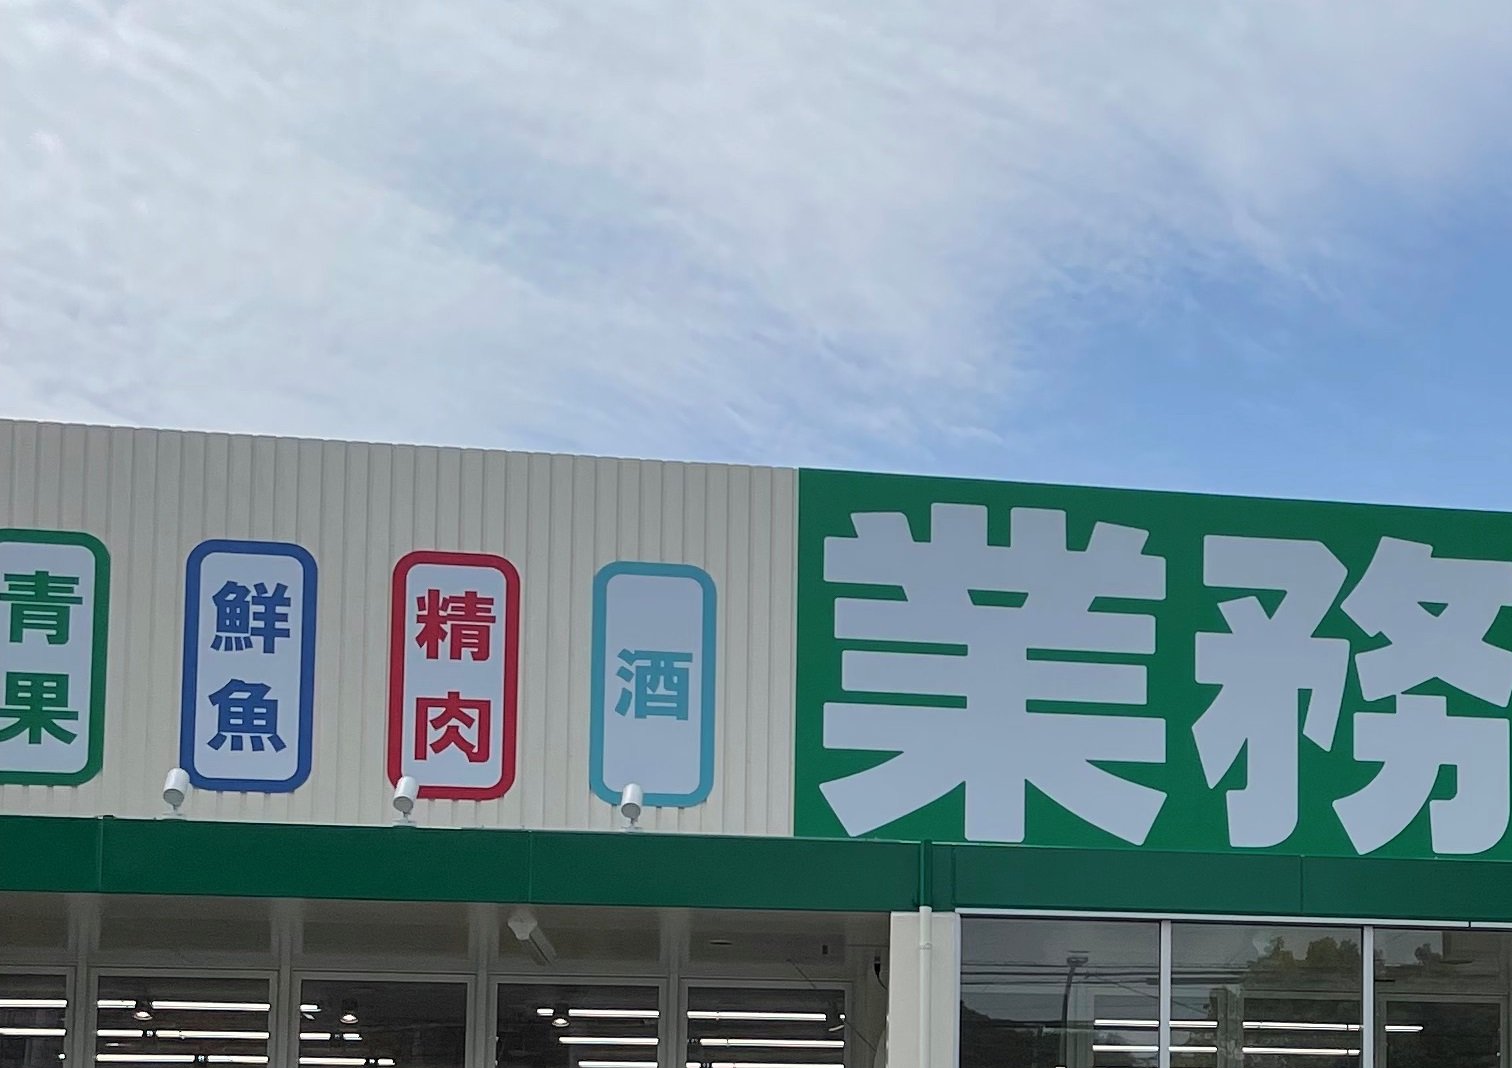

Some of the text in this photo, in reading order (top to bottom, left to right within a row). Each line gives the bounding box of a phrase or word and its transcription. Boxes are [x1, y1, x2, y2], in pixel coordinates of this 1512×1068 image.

[0, 571, 83, 745] 青果
[207, 580, 291, 753] 鮮魚
[415, 589, 496, 763] 精肉
[615, 648, 693, 721] 酒
